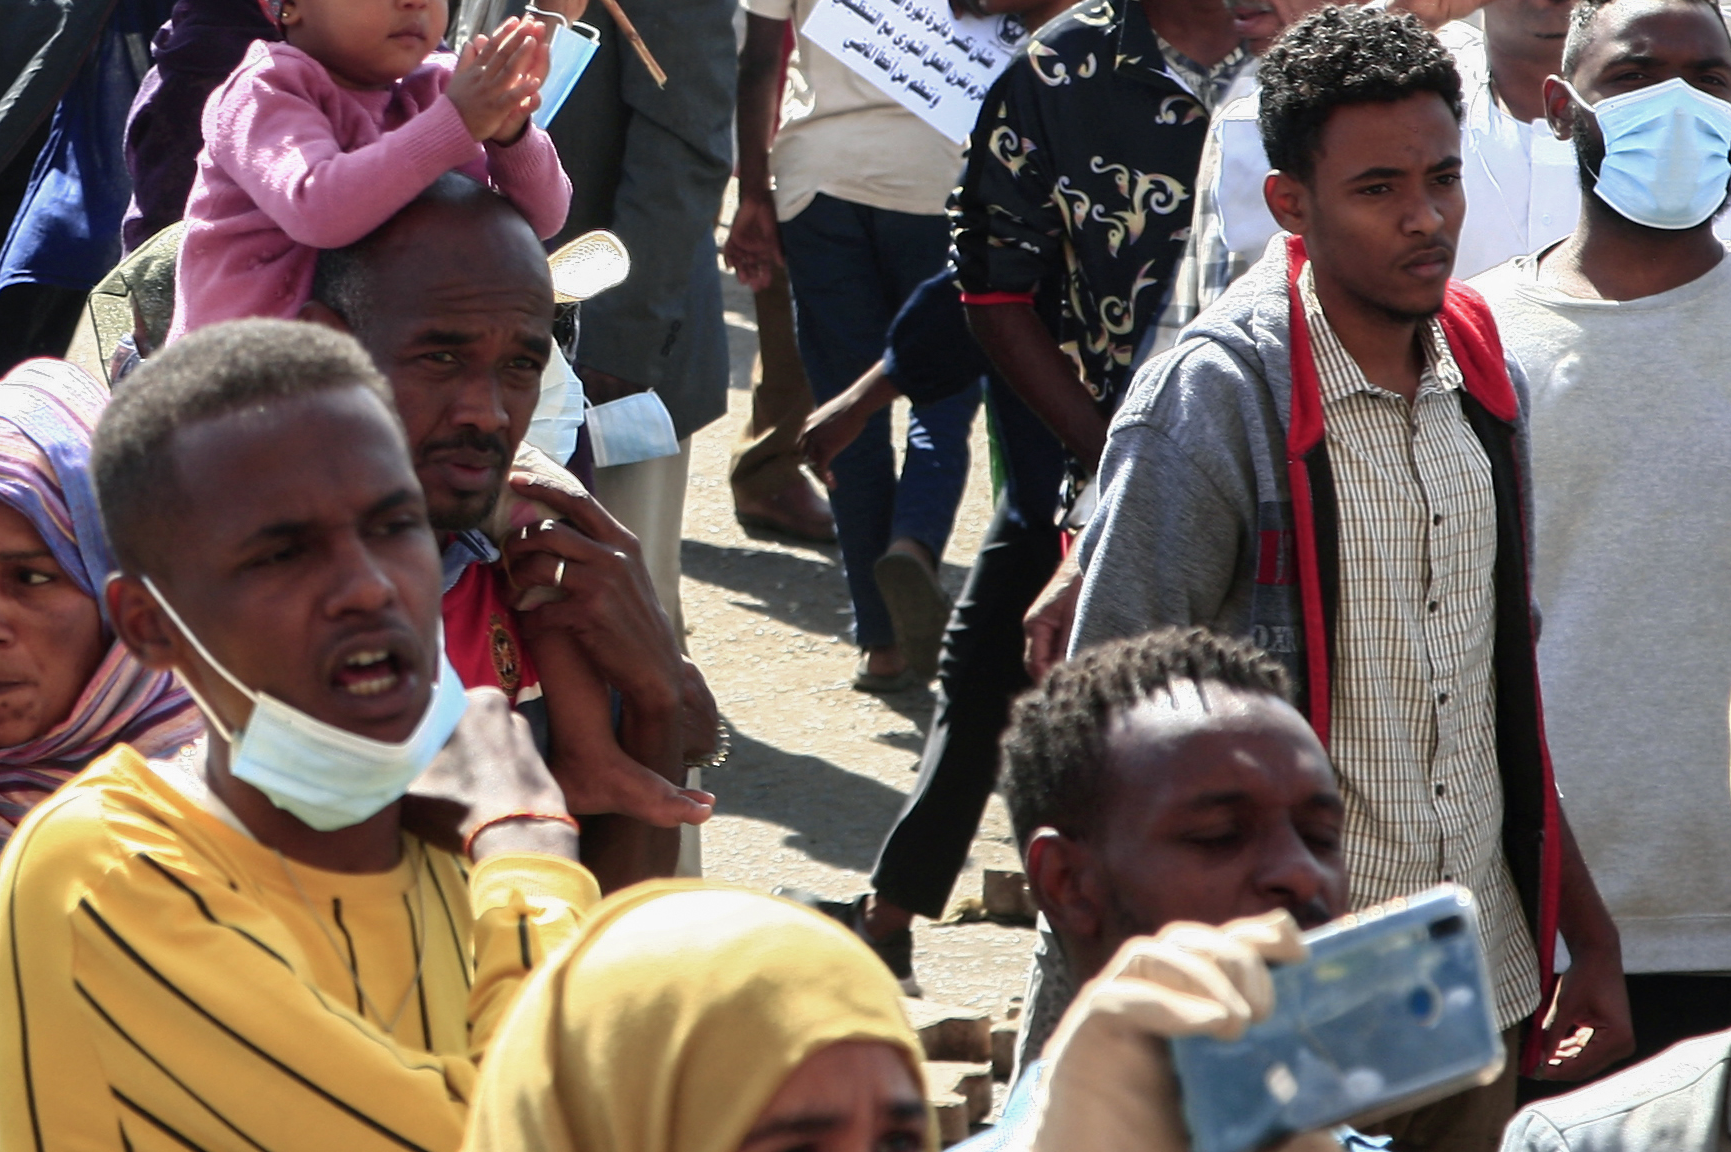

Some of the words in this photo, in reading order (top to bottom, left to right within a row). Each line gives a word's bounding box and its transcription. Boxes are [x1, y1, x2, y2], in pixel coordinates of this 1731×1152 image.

[876, 20, 894, 37] مع
[842, 37, 878, 60] الماضي
[891, 33, 929, 58] الثوري
[889, 68, 909, 84] من
[921, 51, 953, 78] الفعل
